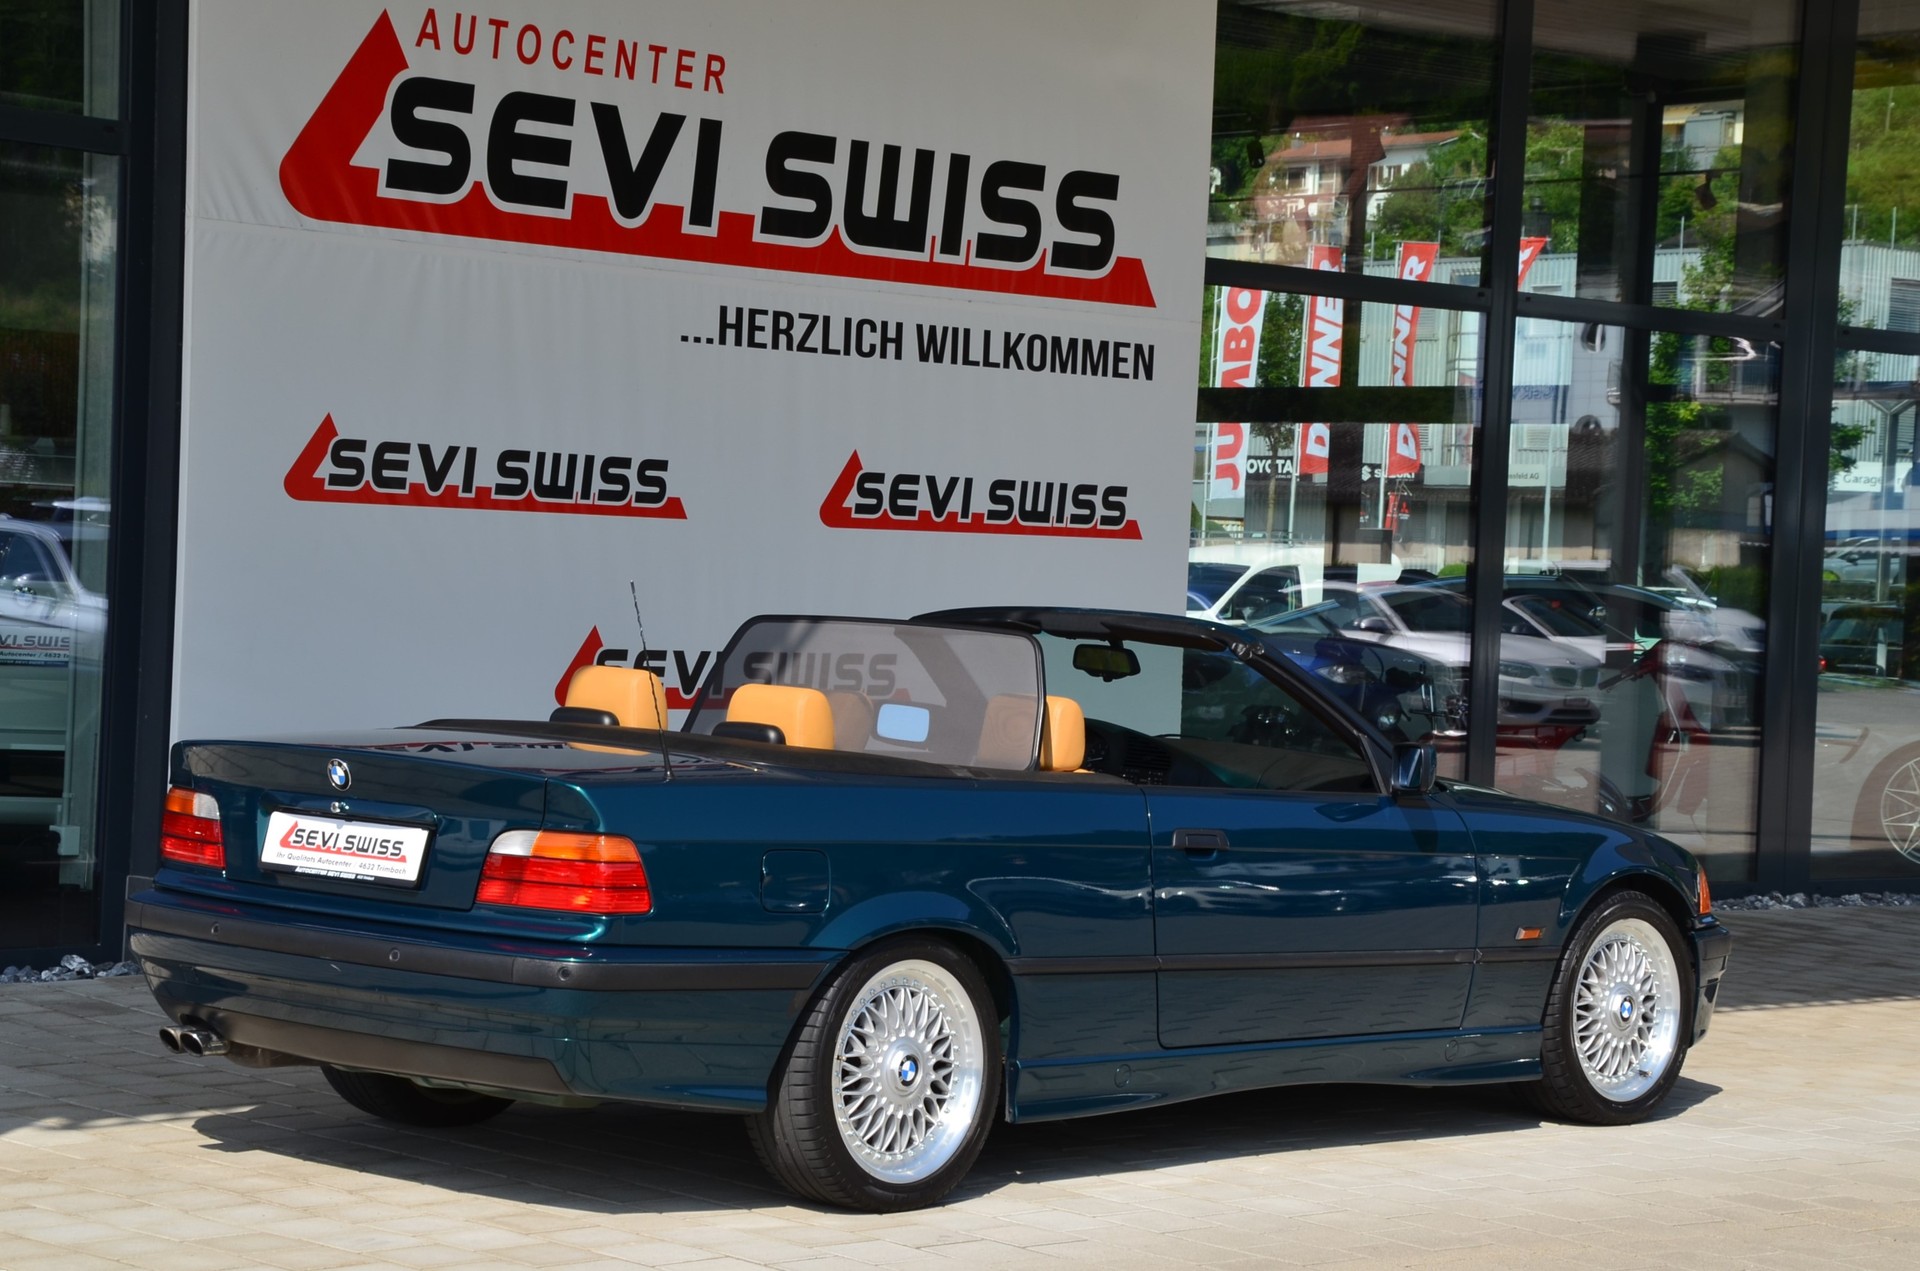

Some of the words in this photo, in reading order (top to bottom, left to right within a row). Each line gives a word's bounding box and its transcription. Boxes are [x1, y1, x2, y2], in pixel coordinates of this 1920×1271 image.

[415, 8, 727, 94] AUTOCENTER
[385, 76, 723, 228] SEVI
[760, 131, 1120, 271] SWISS
[916, 323, 1155, 381] WILLKOMMEN
[328, 438, 477, 494] SEVI
[494, 449, 669, 504] SWISS
[1246, 458, 1293, 474] OYOTA
[851, 471, 974, 521] SEVI
[986, 479, 1128, 527] SWISS
[24, 636, 69, 648] SWIS
[743, 651, 898, 696] SWISS
[292, 828, 340, 849] SEVI
[343, 834, 404, 857] SWISS
[317, 857, 352, 869] Autocenter
[358, 862, 375, 871] 4632
[376, 865, 407, 875] Trimbach
